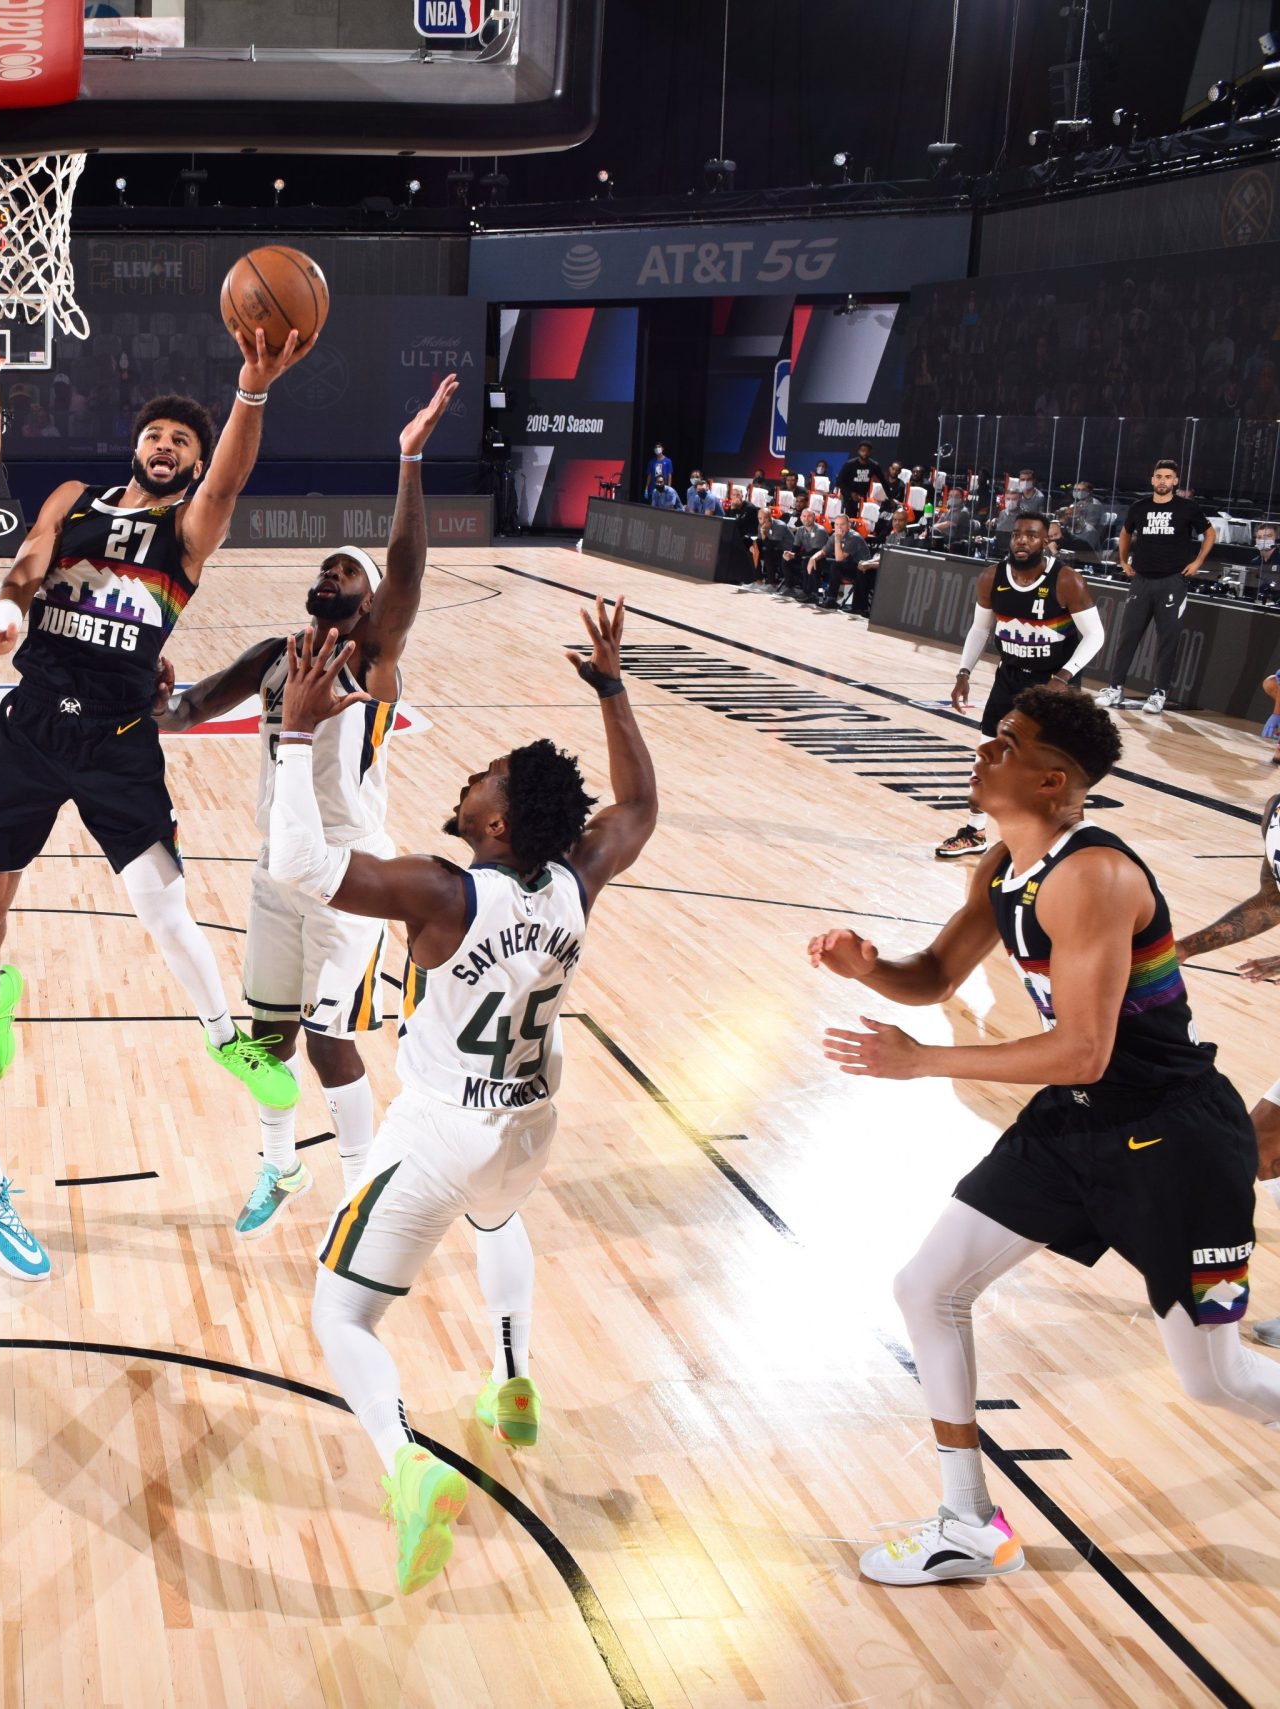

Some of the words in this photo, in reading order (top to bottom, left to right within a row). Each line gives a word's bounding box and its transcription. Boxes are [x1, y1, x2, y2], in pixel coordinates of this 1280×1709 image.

[425, 1, 458, 26] NBA
[636, 241, 754, 286] AT&T
[756, 237, 839, 282] 5G
[400, 350, 474, 368] ULTRA
[526, 415, 565, 433] 2019-20
[567, 415, 603, 433] Season
[818, 418, 901, 438] #WholeNewGam
[265, 510, 298, 539] NBA
[301, 510, 326, 544] App
[343, 510, 394, 539] NBA.c
[438, 517, 477, 533] LIVE
[1146, 512, 1173, 520] BLACK
[1148, 519, 1169, 527] LIVES
[104, 518, 157, 564] 27
[1142, 526, 1175, 535] MATTER
[694, 542, 713, 561] LIVE
[900, 565, 936, 627] TAP
[934, 571, 963, 634] TO
[1031, 599, 1045, 620] 4
[38, 606, 140, 651] NUGGETS
[1001, 640, 1051, 658] NUGGETS
[1015, 905, 1030, 957] 1
[452, 937, 498, 986] SAY
[499, 922, 541, 959] HER
[456, 983, 563, 1080] 45
[1192, 1241, 1254, 1266] DENVER
